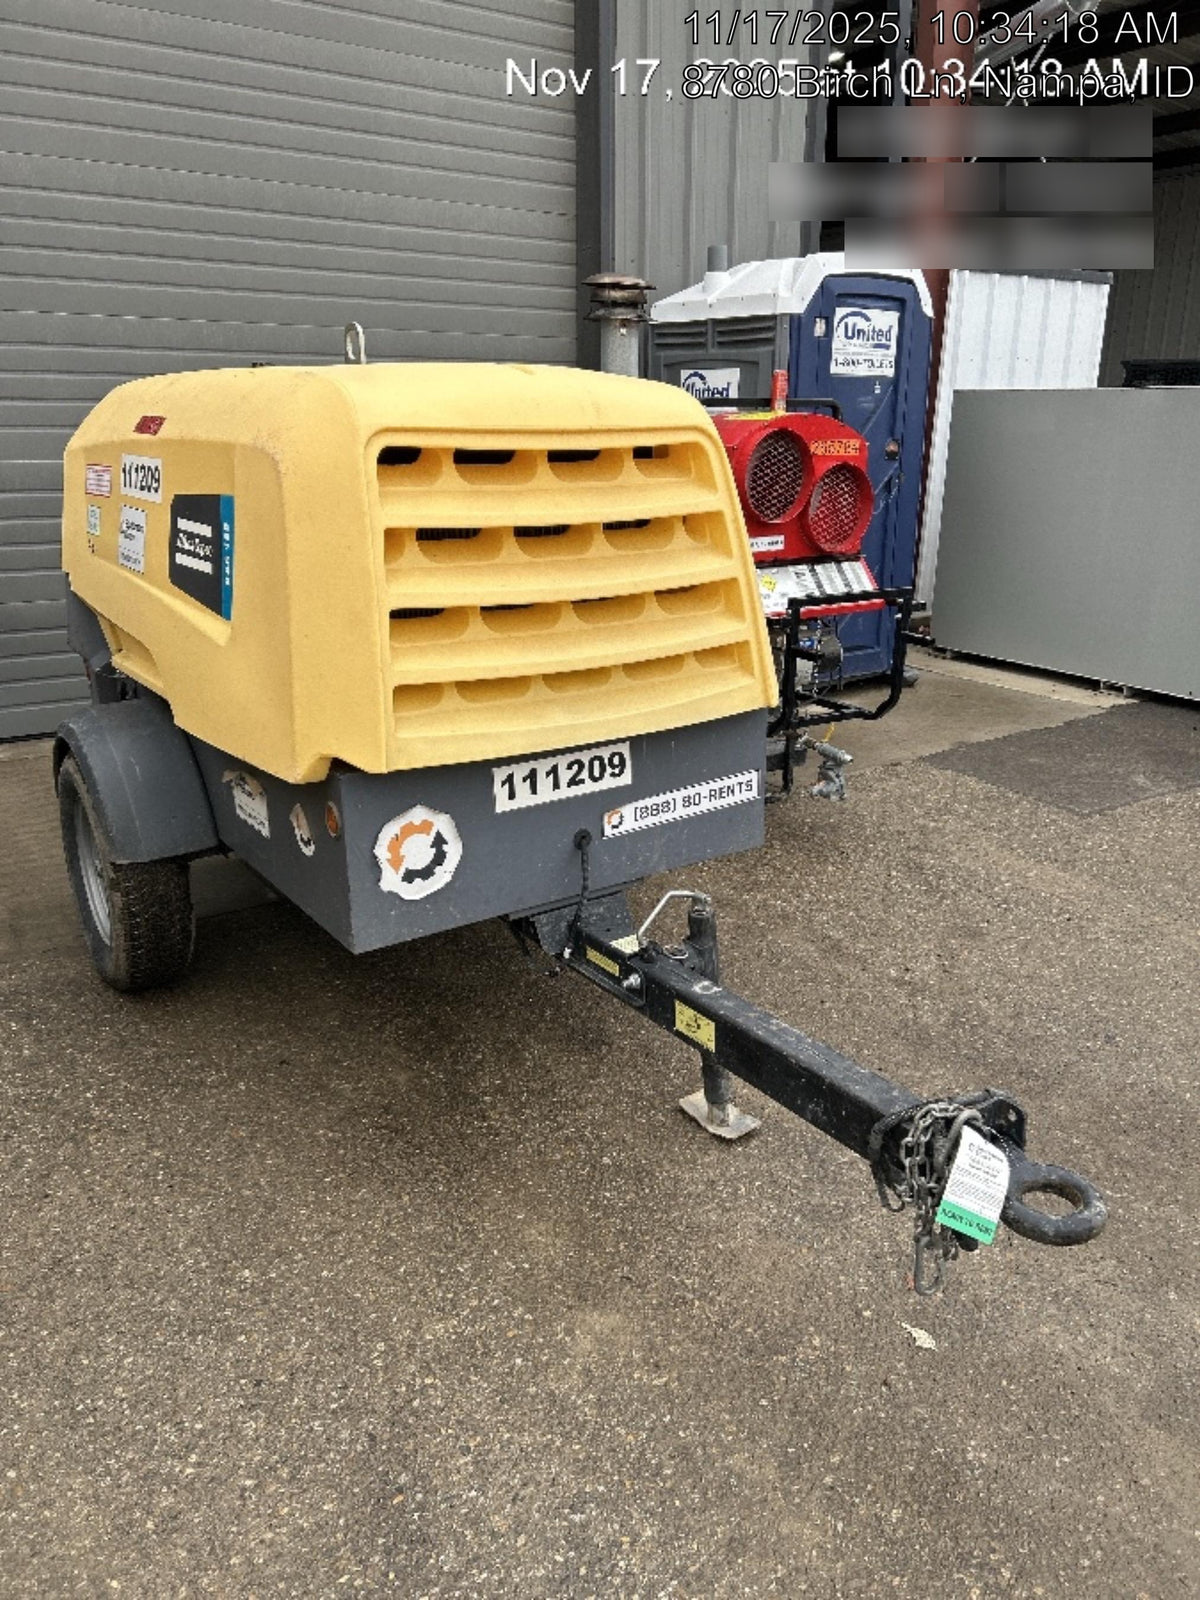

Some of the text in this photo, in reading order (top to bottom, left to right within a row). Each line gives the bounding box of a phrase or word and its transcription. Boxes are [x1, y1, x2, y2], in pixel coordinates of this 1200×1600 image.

[844, 321, 893, 342] United
[122, 462, 160, 493] 111209
[501, 752, 626, 800] 111209
